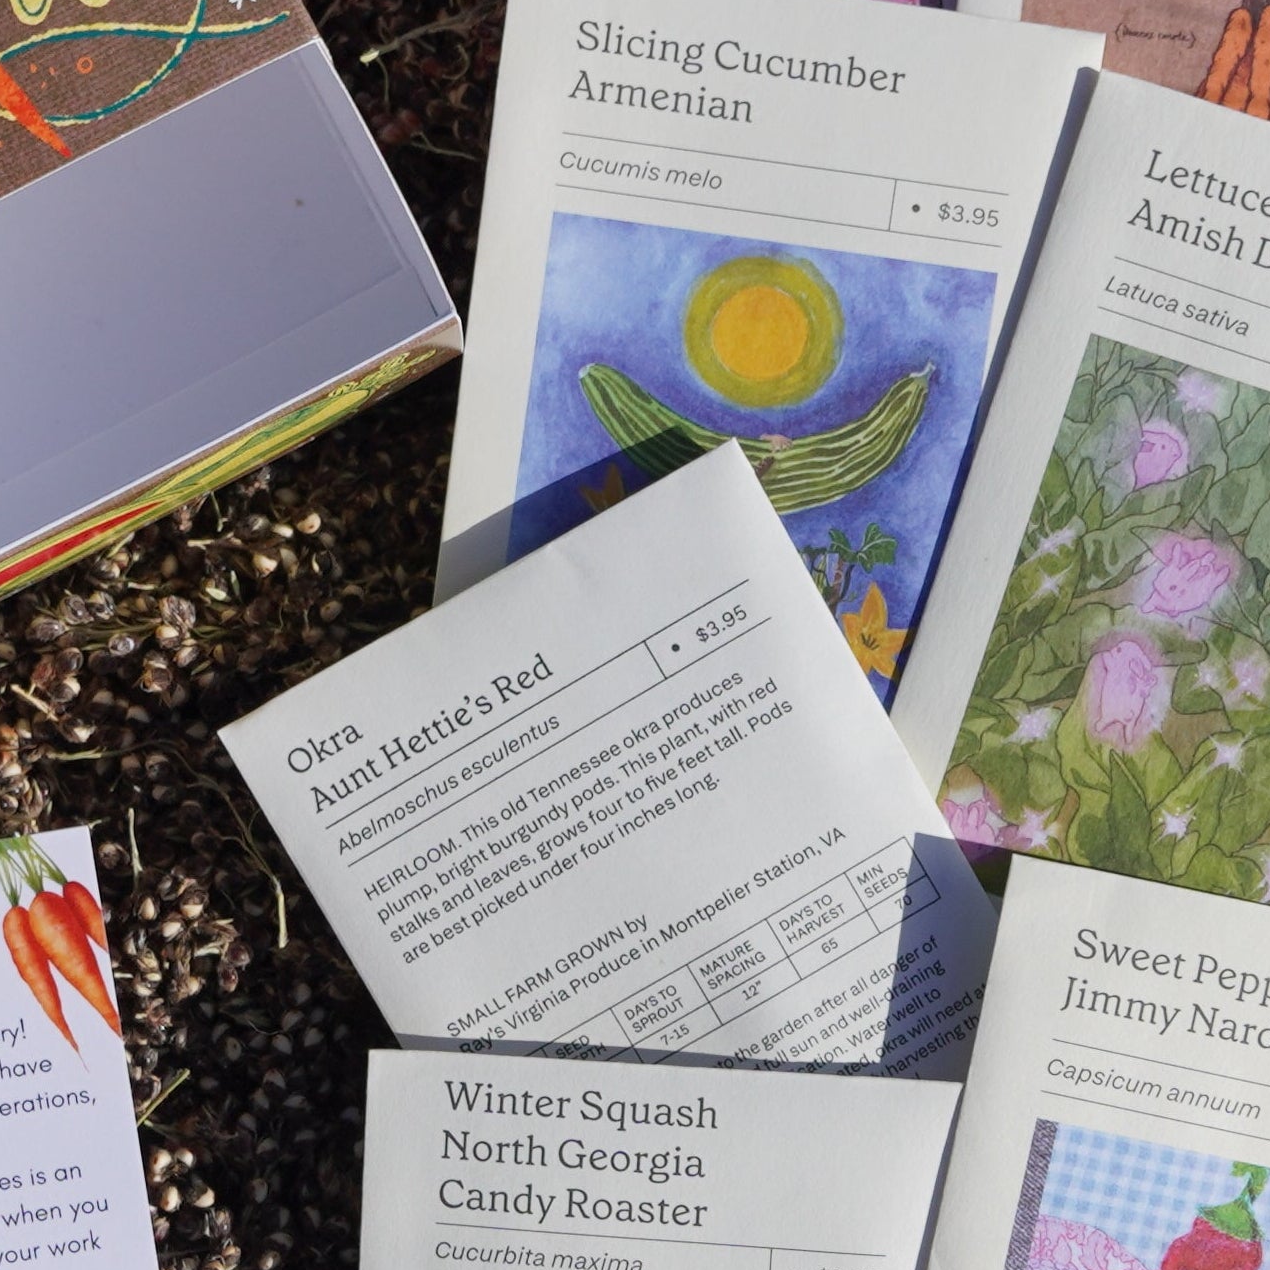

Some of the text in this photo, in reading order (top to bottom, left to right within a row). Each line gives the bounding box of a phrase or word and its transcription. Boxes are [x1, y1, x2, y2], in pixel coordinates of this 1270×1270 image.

[576, 20, 906, 94] Slicing Cucumber
[567, 69, 752, 124] Armenian
[559, 151, 723, 190] Cucumis melo
[937, 201, 999, 228] $3.95
[1126, 198, 1245, 261] Amish
[1104, 275, 1250, 337] Latuca sativa
[695, 604, 747, 643] $3.95
[287, 724, 364, 774] Okra
[310, 652, 554, 814] Aunt Hettie's Red
[339, 715, 560, 856] Abelmoschus esculentus
[363, 672, 744, 902] HEIRLOOM. This old Tennessee okra produces
[377, 676, 778, 926] plump, bright burgundy pods. This plant, with red
[778, 894, 833, 932] DAYS TO
[785, 903, 845, 945] HARVEST
[446, 914, 647, 1038] SMALL FARM GROWN by
[698, 939, 754, 978] MATURE
[706, 951, 767, 990] SPACING
[1073, 928, 1187, 980] Sweet
[1059, 975, 1182, 1036] Jimmy
[443, 1080, 718, 1132] Winter Squash
[1047, 1058, 1261, 1120] Capsicum annuum
[441, 1129, 706, 1184] North Georgia
[438, 1178, 708, 1227] Candy Roaster
[435, 1241, 546, 1267] Cucurbita
